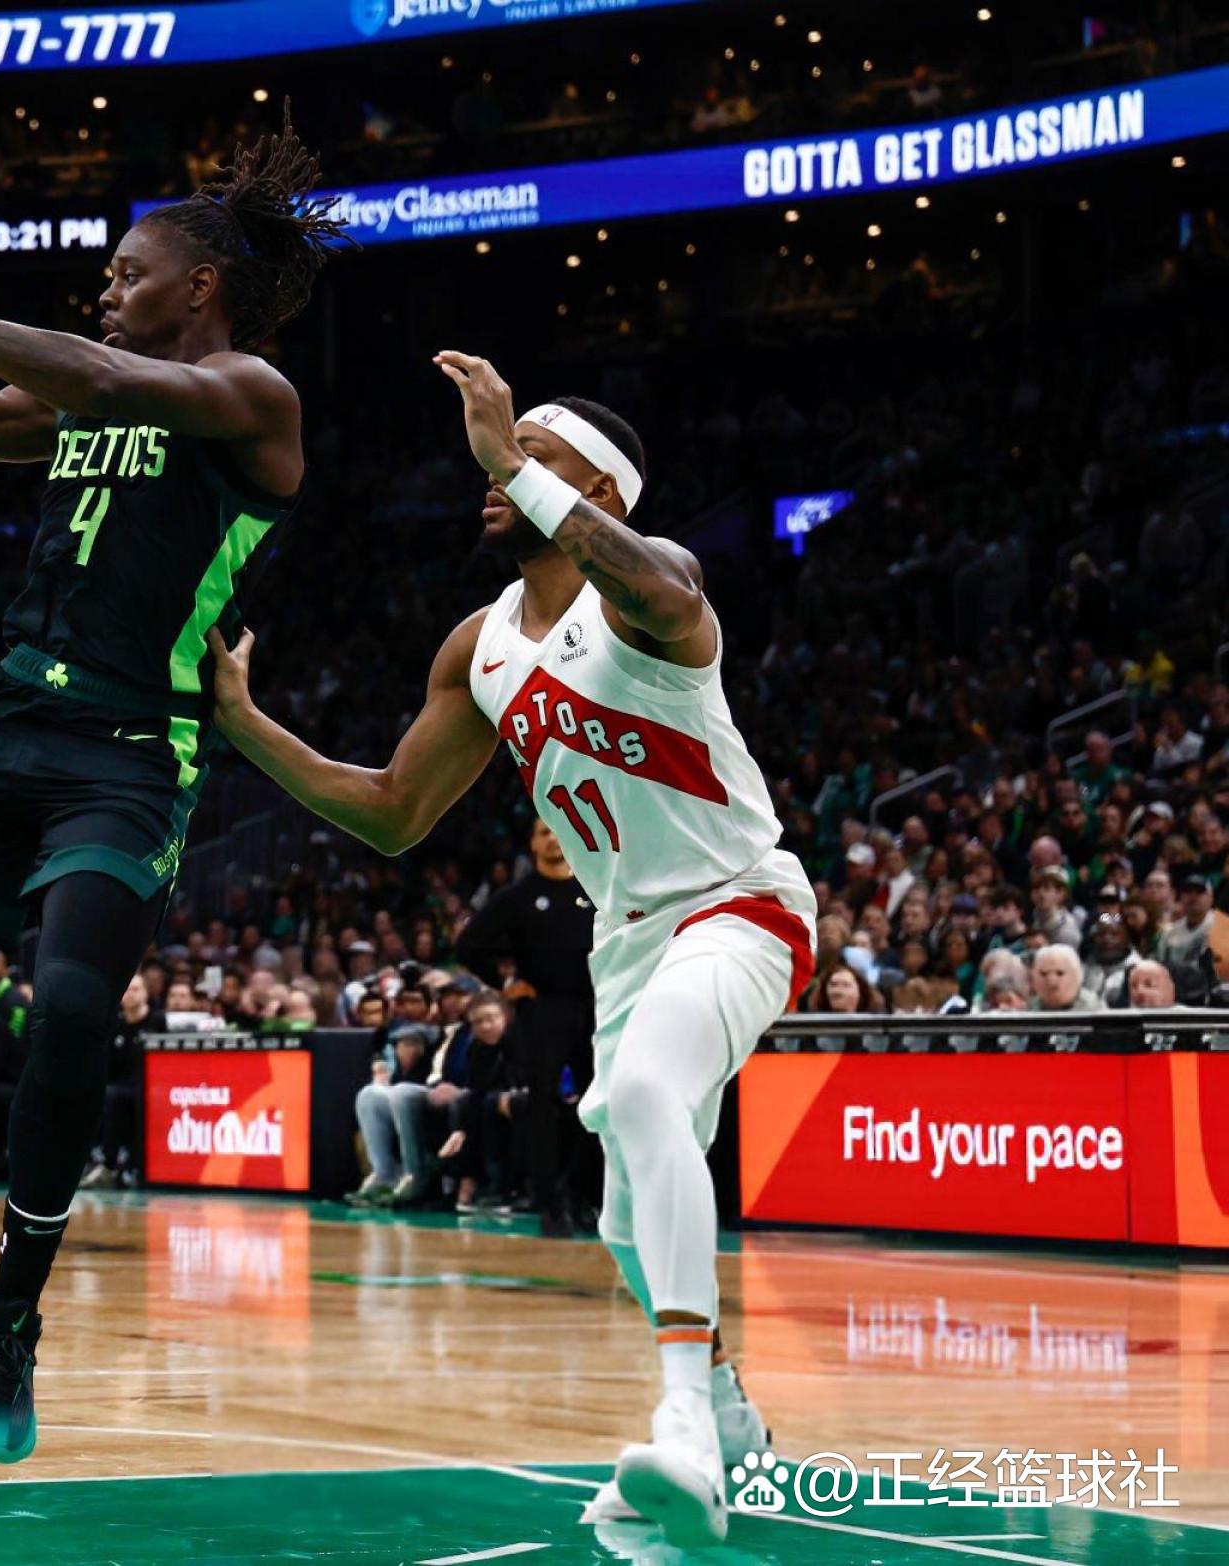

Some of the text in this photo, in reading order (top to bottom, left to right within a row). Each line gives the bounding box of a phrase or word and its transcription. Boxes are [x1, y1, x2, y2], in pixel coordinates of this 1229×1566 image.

[743, 89, 1144, 198] GOTTA GET GLASSMAN
[60, 217, 107, 249] PM
[48, 425, 169, 480] CELTICS
[69, 486, 110, 567] 4
[507, 690, 647, 768] APTORS
[546, 778, 620, 853] 11
[843, 1105, 1124, 1183] Find your pace
